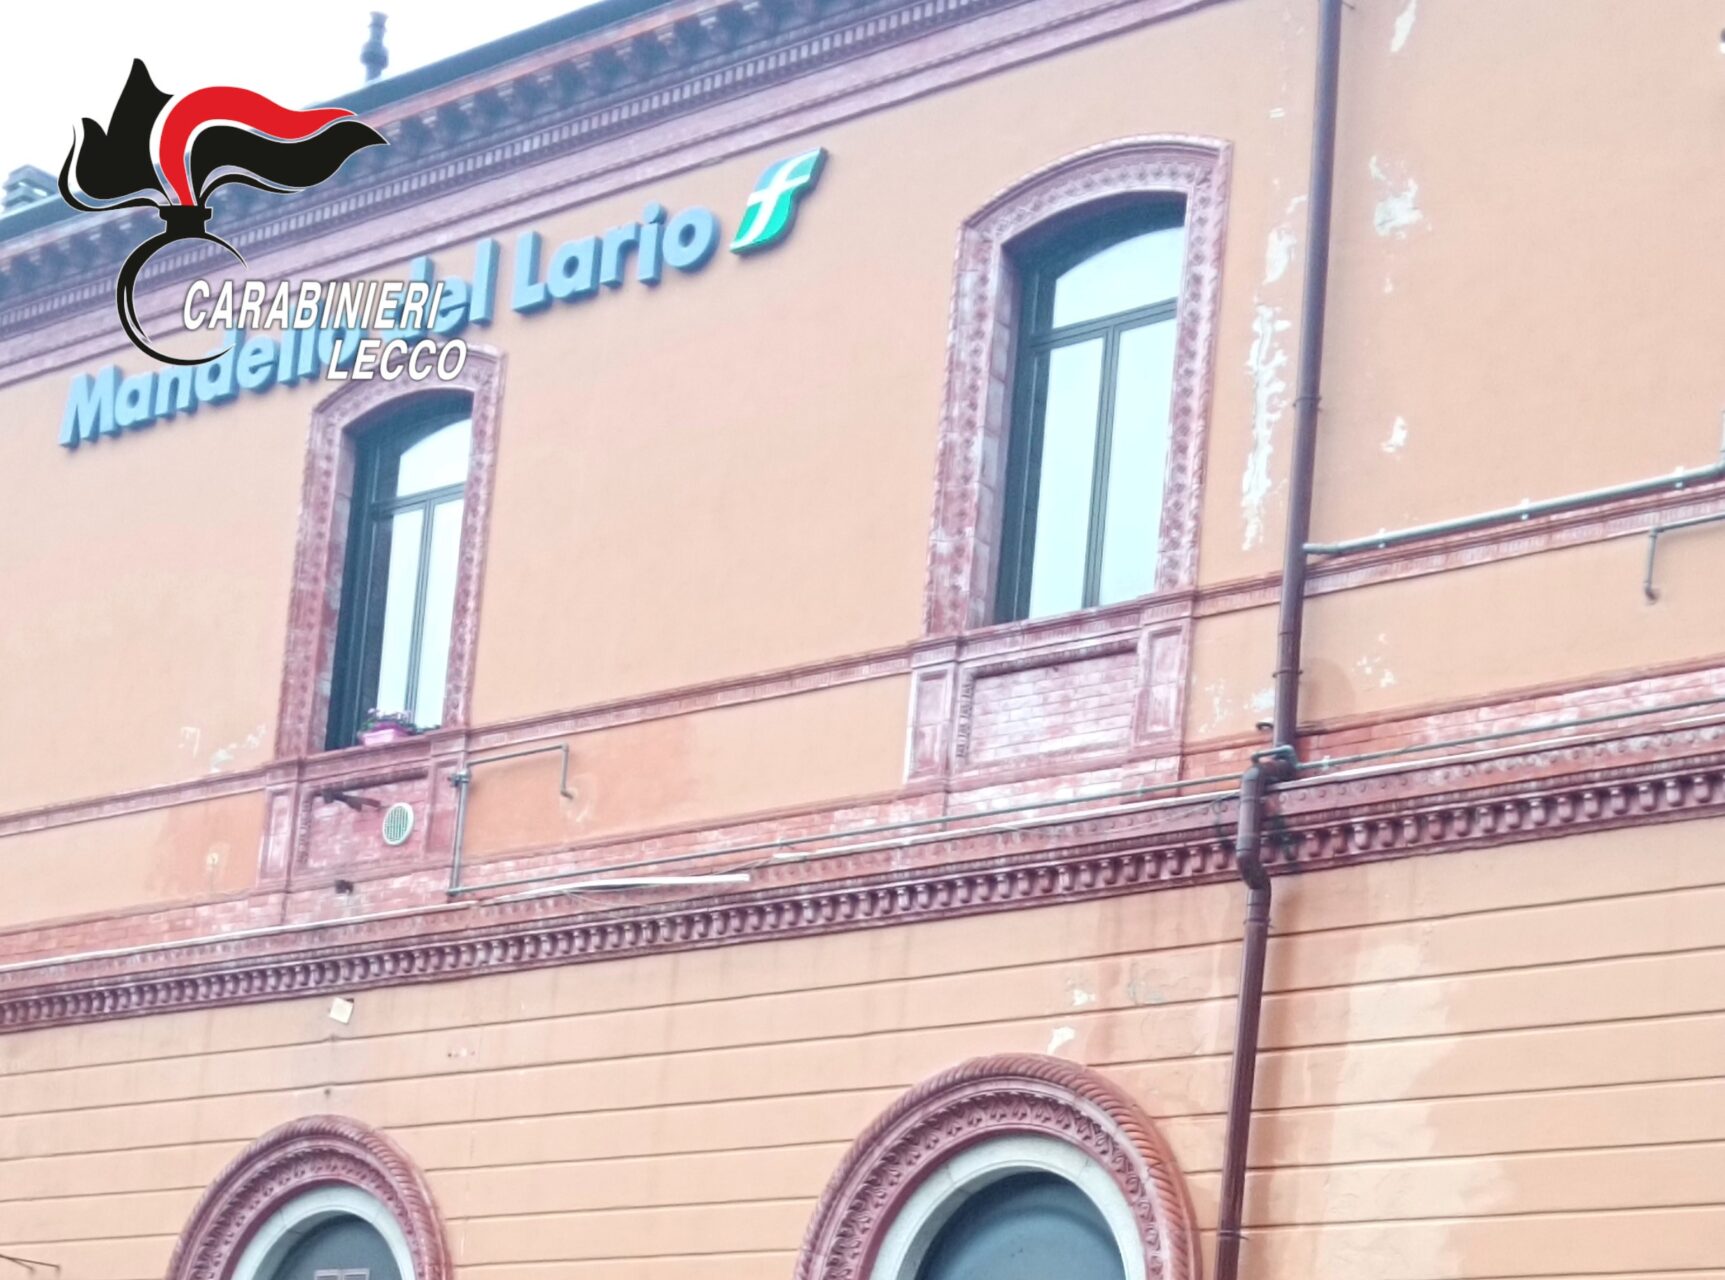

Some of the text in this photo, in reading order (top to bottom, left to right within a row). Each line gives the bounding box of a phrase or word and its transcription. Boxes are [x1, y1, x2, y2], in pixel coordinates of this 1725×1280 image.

[58, 200, 721, 450] Mandello del Lario
